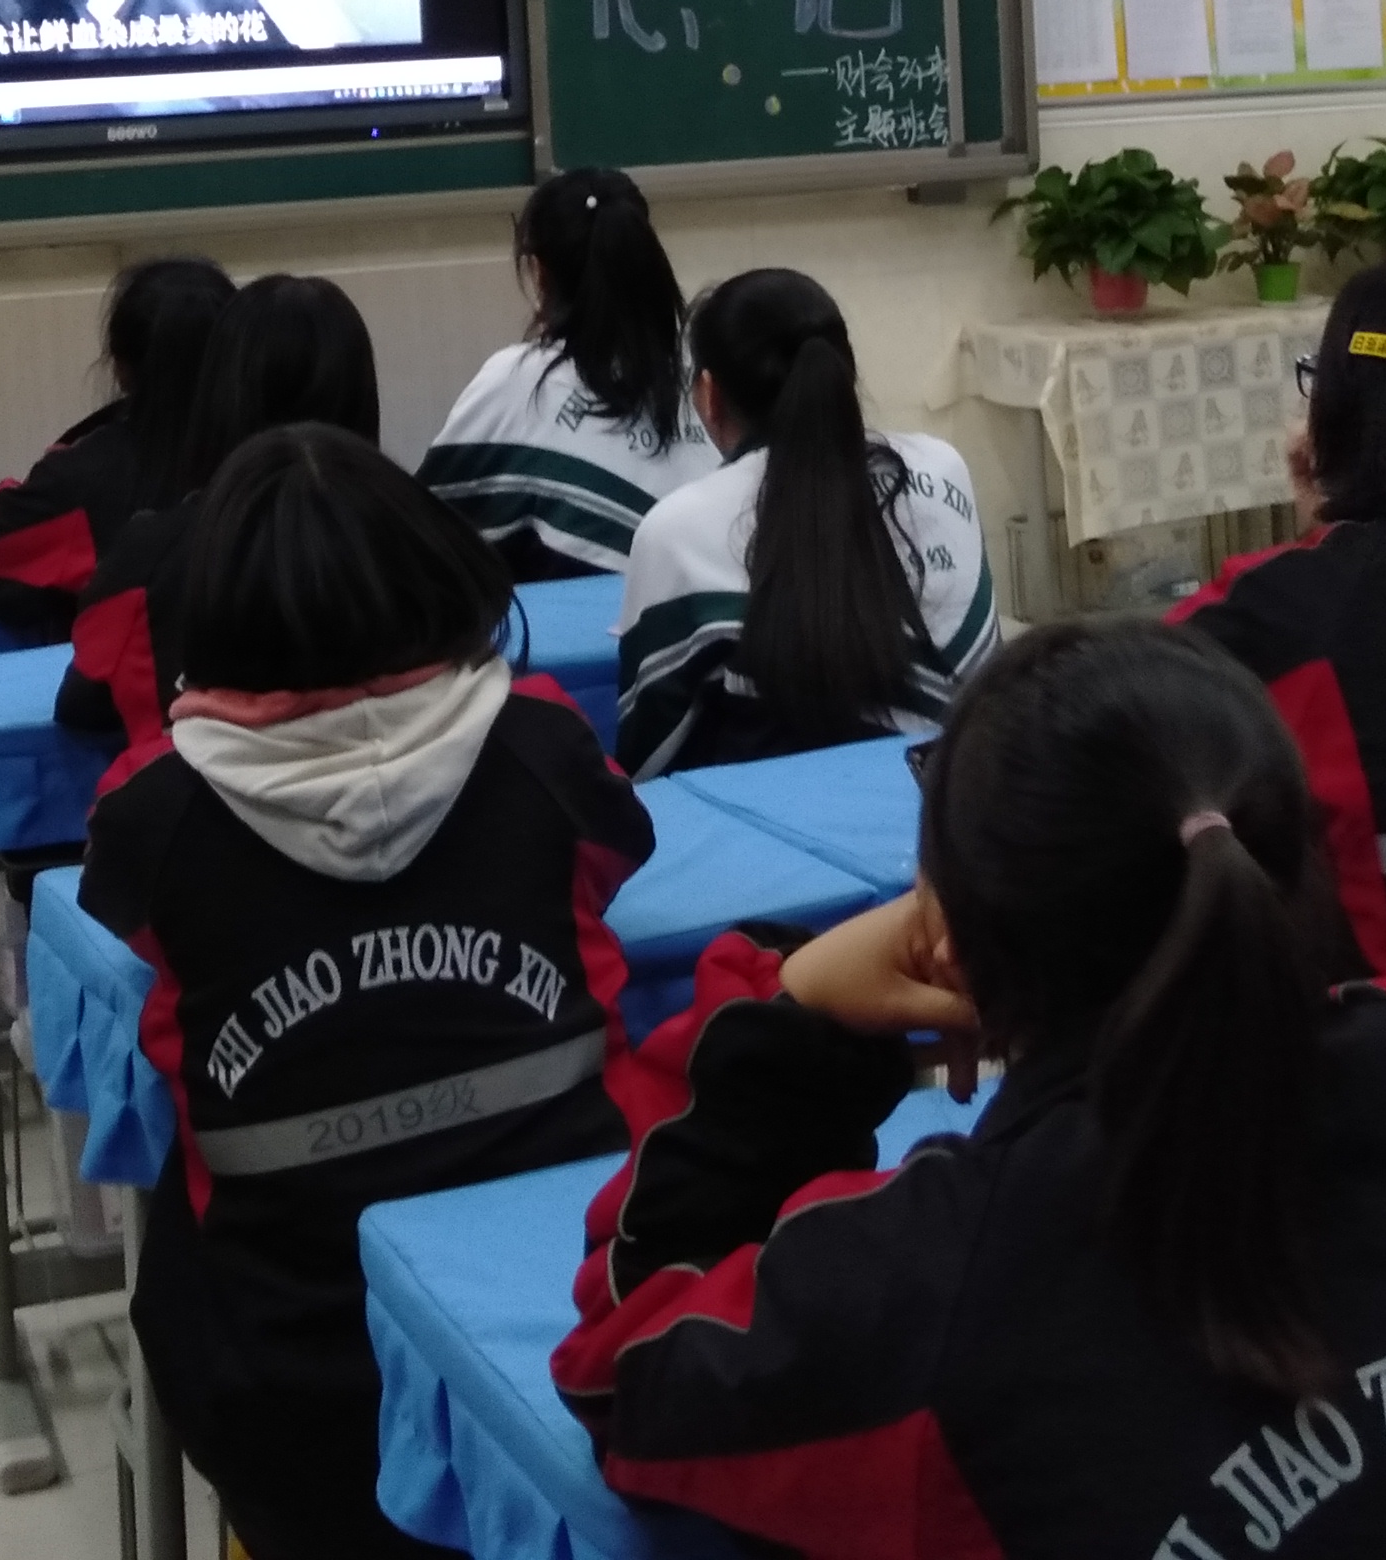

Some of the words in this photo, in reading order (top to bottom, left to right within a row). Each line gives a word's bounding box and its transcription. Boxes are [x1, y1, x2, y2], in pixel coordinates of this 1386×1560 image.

[942, 477, 974, 524] XIN
[207, 1012, 264, 1100] ZHI
[252, 949, 343, 1039] JIAO
[351, 924, 502, 990] ZHONG
[505, 942, 569, 1023] XIN
[1210, 1396, 1365, 1552] JIAO
